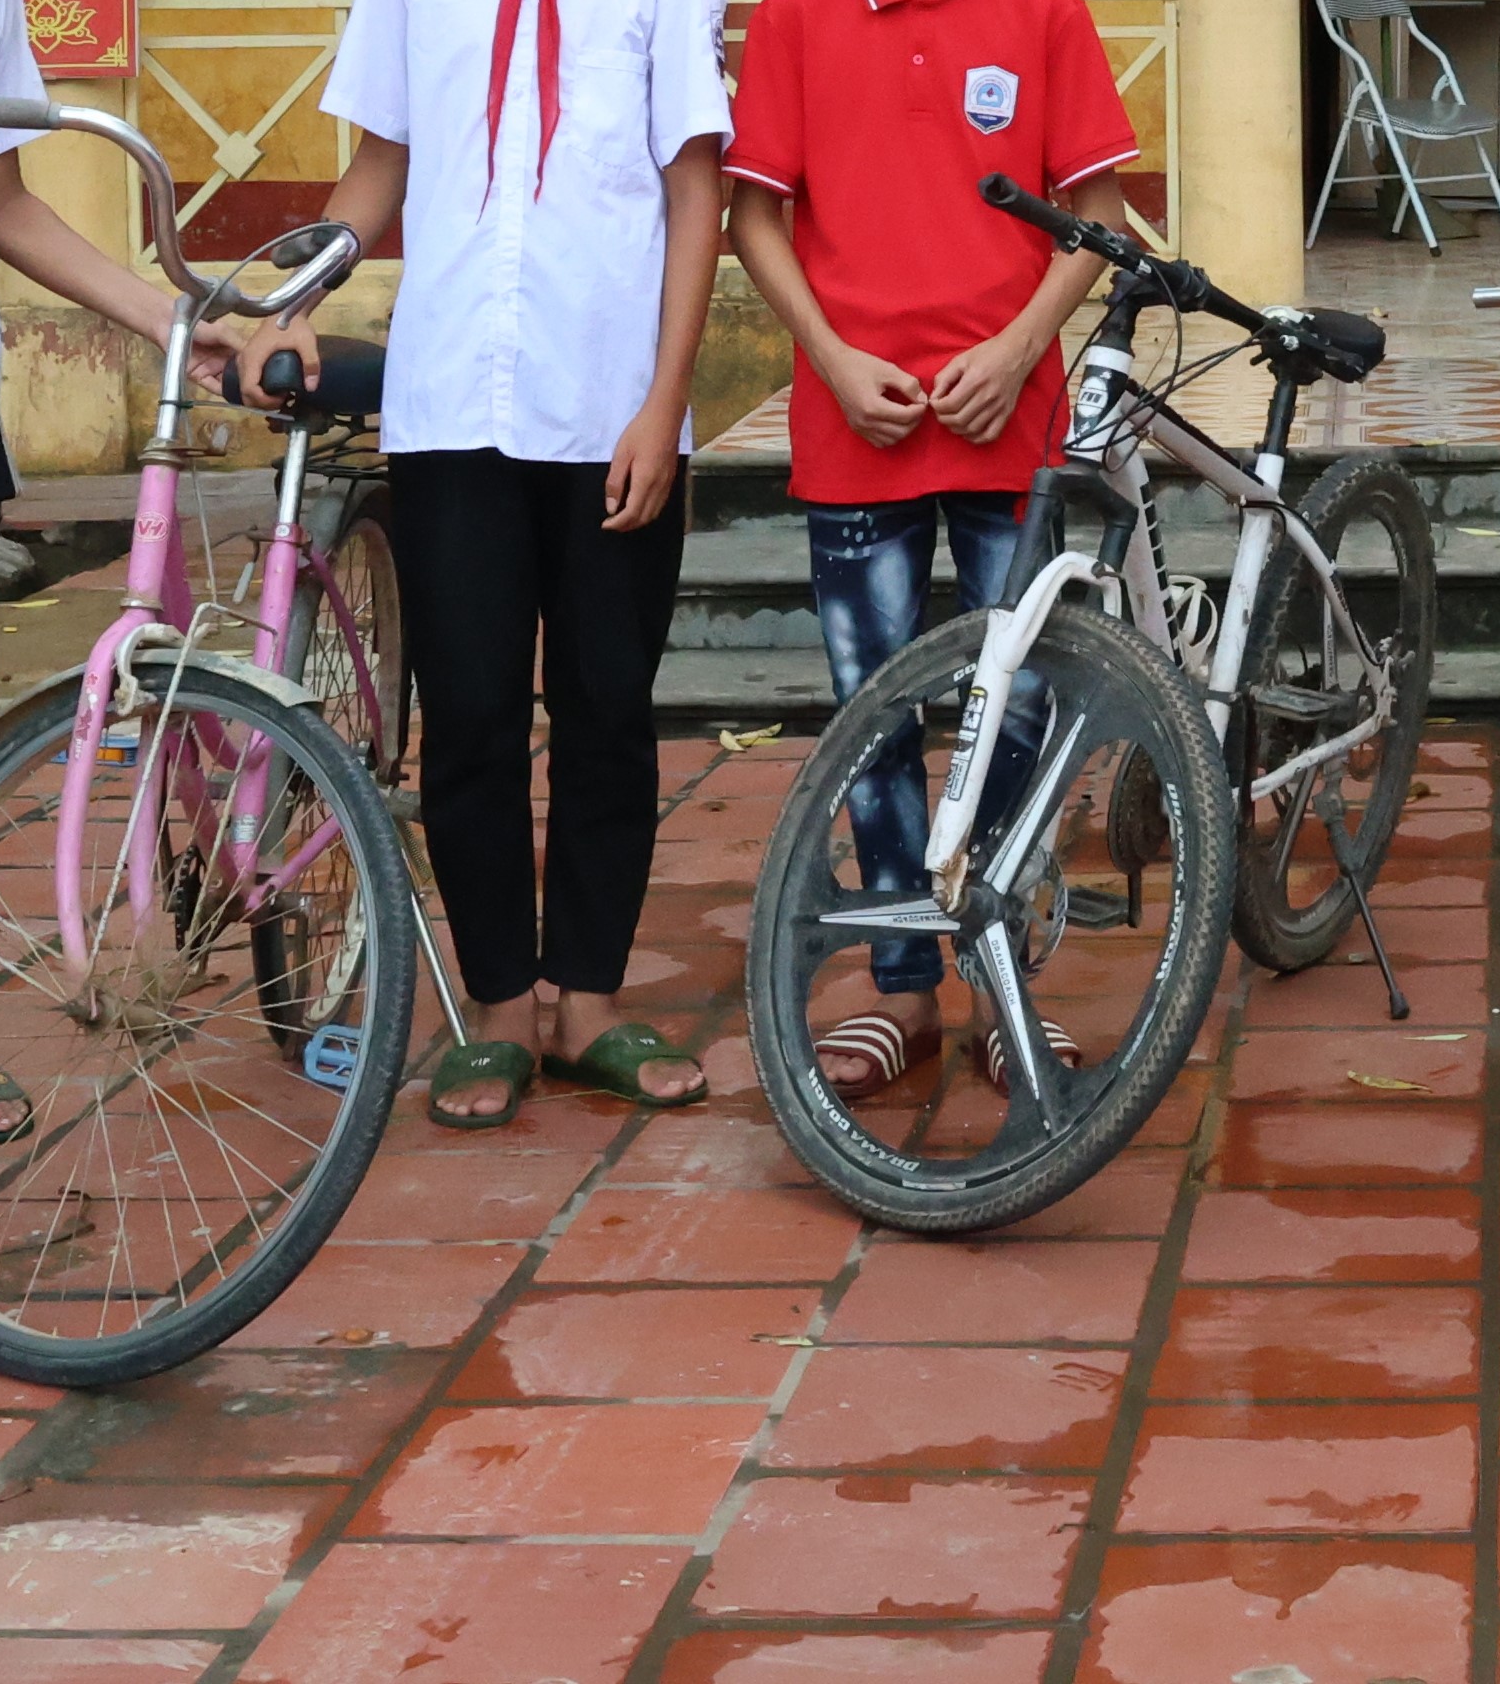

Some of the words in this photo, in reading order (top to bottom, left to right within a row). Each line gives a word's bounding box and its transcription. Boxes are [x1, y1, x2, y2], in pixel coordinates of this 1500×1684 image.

[990, 939, 1015, 1006] DRAMACOACH
[808, 1066, 851, 1132] COACH
[850, 1129, 920, 1173] DRAMA
